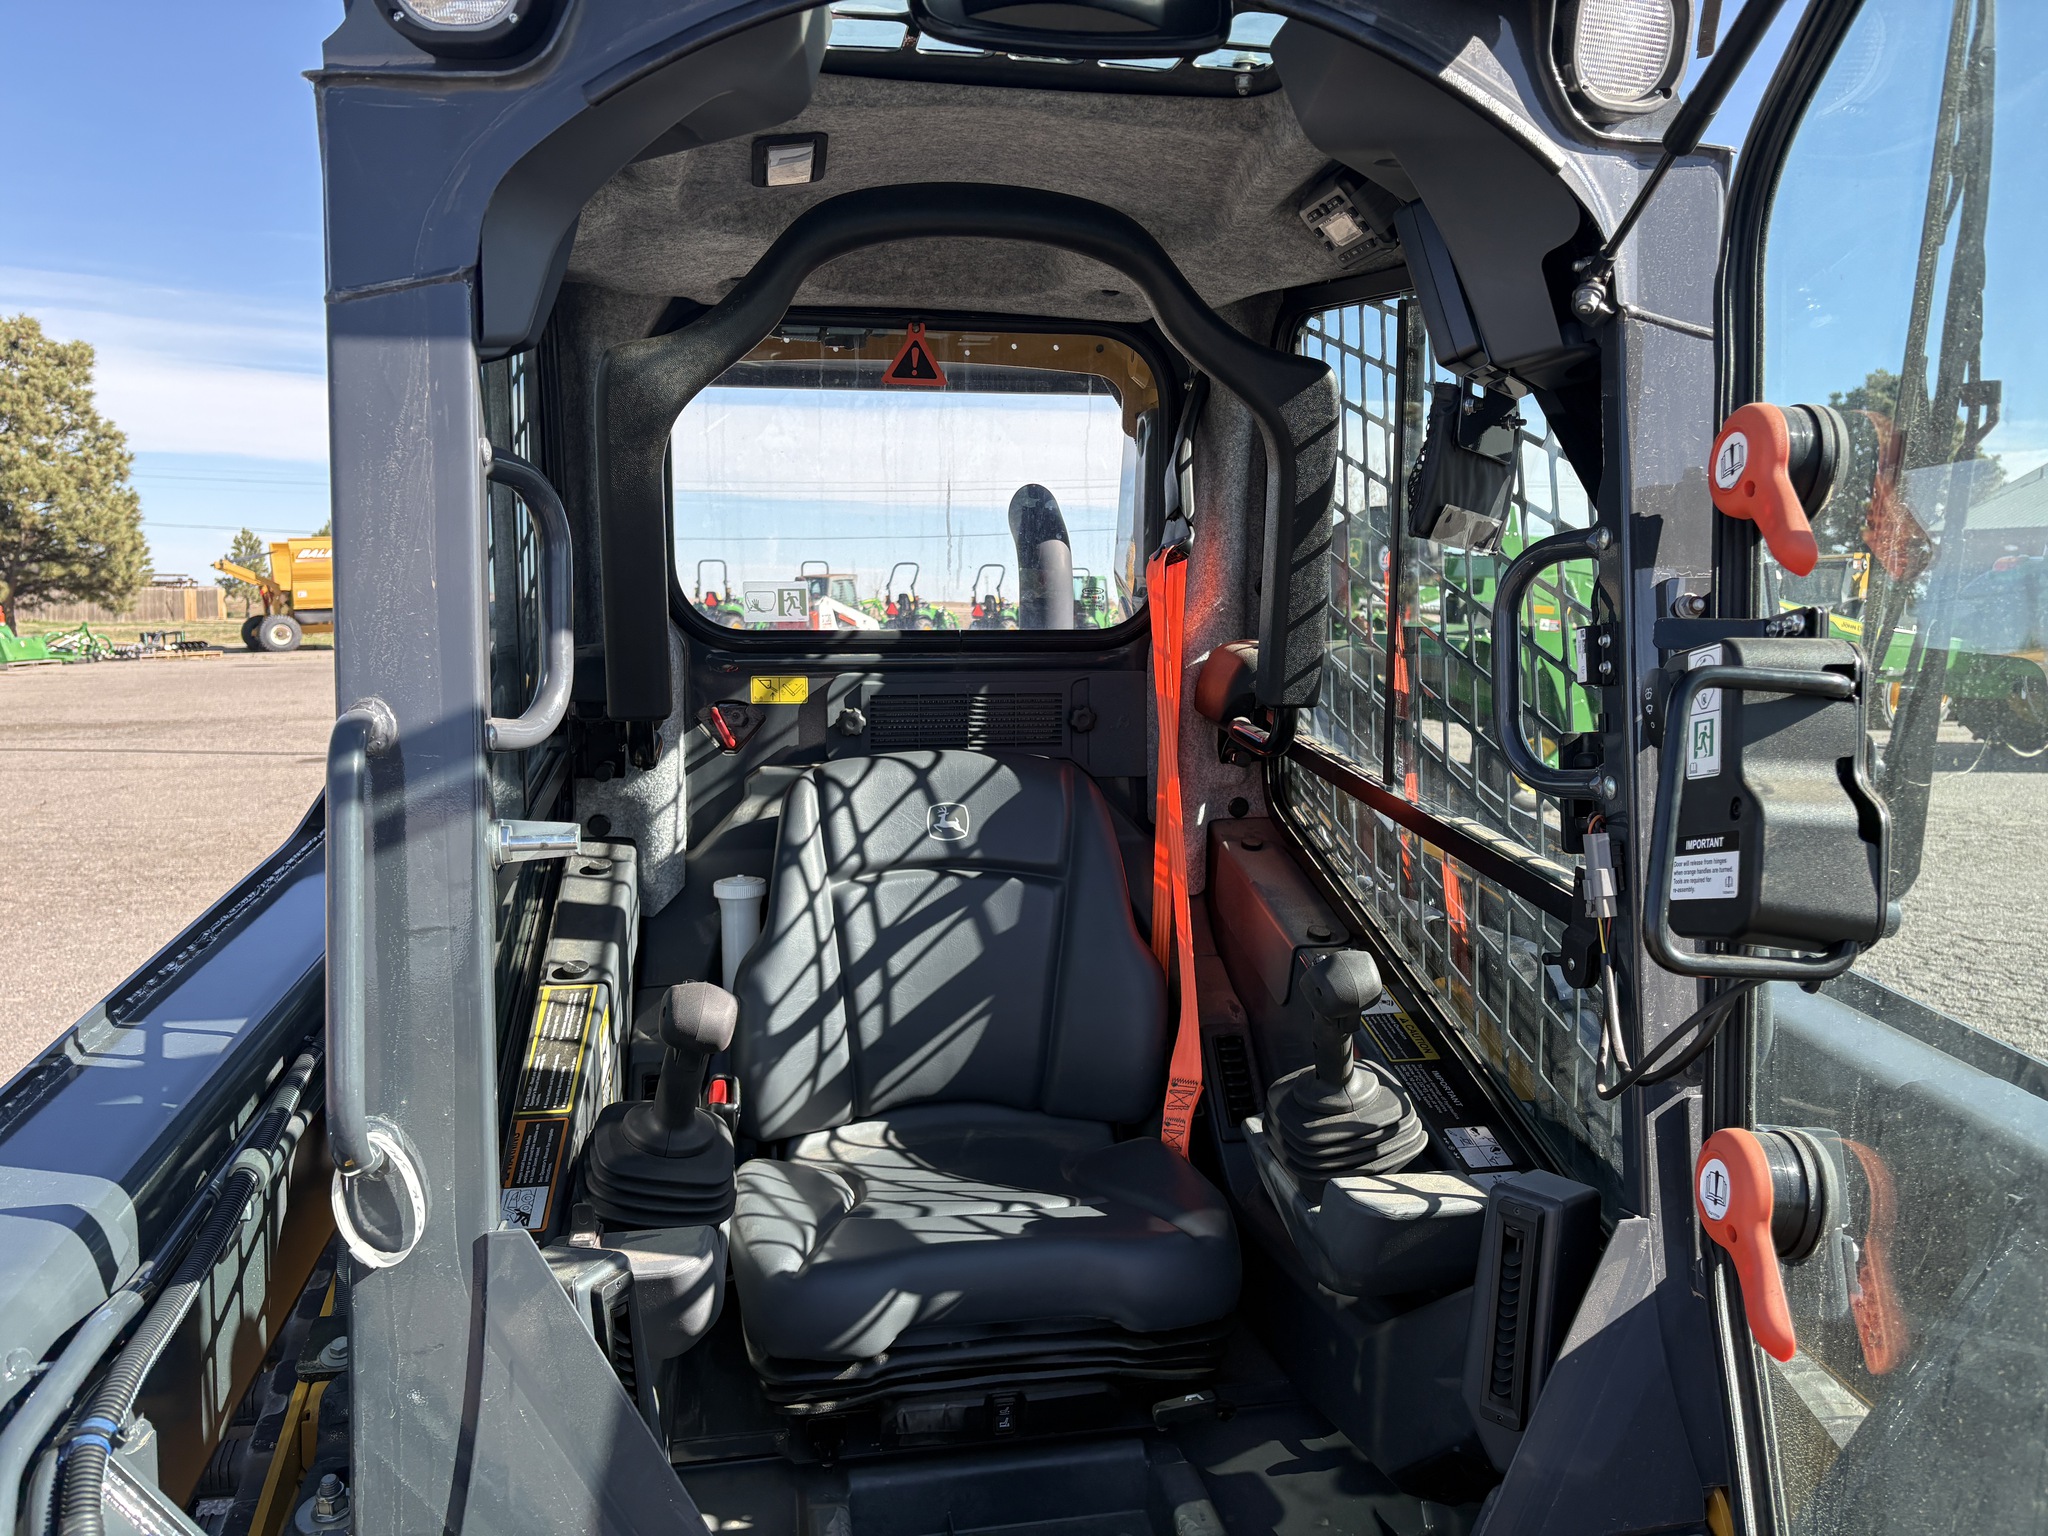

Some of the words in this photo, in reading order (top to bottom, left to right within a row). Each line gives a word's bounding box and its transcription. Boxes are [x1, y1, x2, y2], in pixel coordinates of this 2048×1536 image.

[1686, 837, 1724, 850] IMPORTANT
[1405, 1023, 1433, 1055] CAUTION
[1431, 1070, 1463, 1107] IMPORTANT
